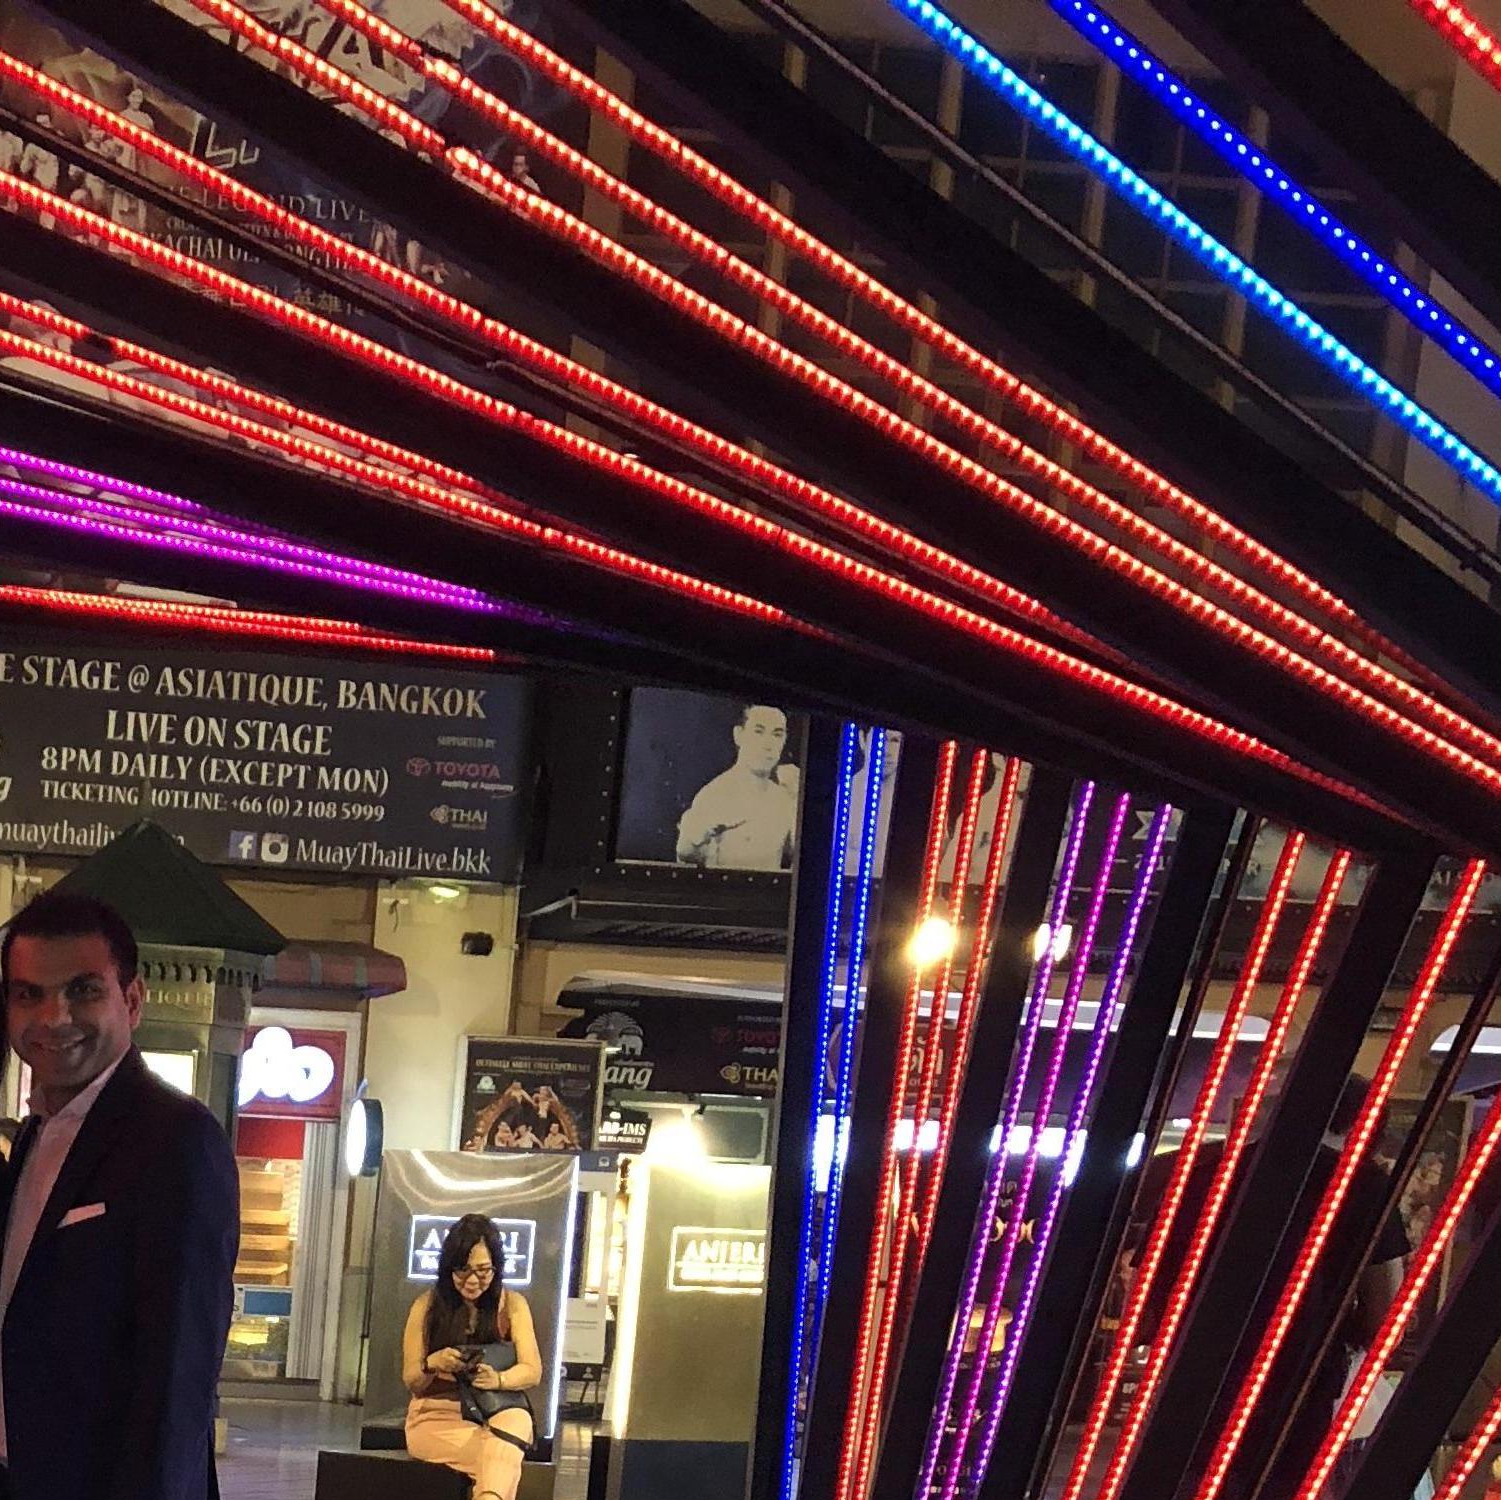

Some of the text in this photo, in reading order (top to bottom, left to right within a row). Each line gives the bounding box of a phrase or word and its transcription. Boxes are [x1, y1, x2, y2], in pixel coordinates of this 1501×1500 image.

[22, 655, 121, 692] STAGE
[128, 664, 150, 693] @
[154, 666, 328, 711] ASIATIQUE,
[336, 678, 487, 719] BANGKOK
[106, 709, 333, 756] LIVE ON STAGE
[41, 746, 389, 797] 8PM DAILY (EXCEPT MON)
[435, 761, 500, 779] TOYOTA
[40, 779, 139, 806] TICKETING
[231, 796, 262, 814] +66
[266, 795, 290, 818] (0)
[293, 799, 304, 818] 2
[307, 801, 337, 820] 108
[342, 802, 386, 822] 5999
[450, 807, 488, 824] THAI
[296, 838, 492, 875] MuayThaiLive.bkk
[605, 1065, 652, 1090] ang
[743, 1066, 779, 1083] THA
